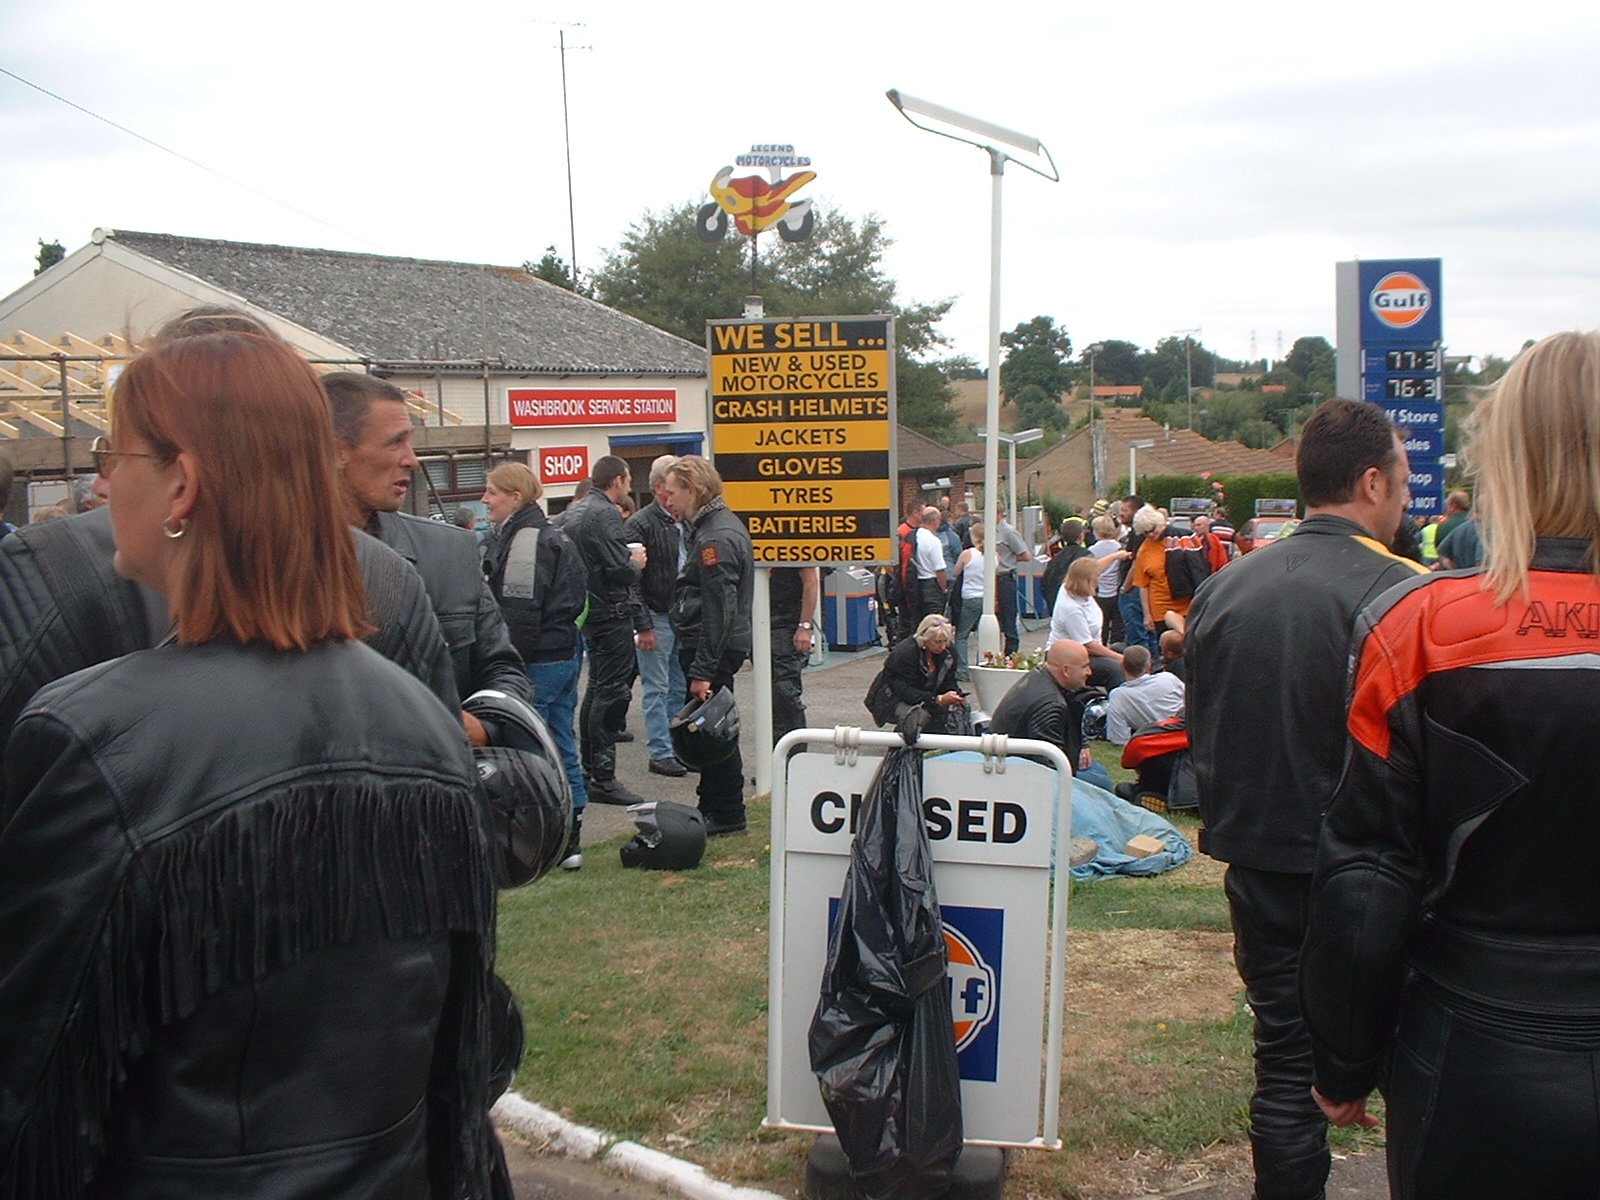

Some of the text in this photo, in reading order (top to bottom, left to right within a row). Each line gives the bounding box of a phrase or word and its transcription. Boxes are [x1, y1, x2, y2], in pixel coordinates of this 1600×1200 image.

[751, 144, 793, 152] LEGEND
[736, 155, 811, 166] MOTORCYCLES
[1374, 293, 1428, 308] Gulf
[715, 324, 764, 350] WE
[774, 321, 848, 349] SELL
[732, 354, 867, 373] NEW & USED
[722, 372, 879, 392] MOTORCYCLES
[513, 398, 673, 417] WASHBROOK SERVICE STATION
[714, 397, 888, 418] CRASH HELMETS
[1398, 408, 1438, 423] Store
[755, 428, 847, 446] JACKETS
[1404, 438, 1430, 450] ales
[544, 455, 583, 476] SHOP
[758, 457, 843, 476] GLOVES
[769, 487, 833, 504] TYRES
[748, 515, 857, 534] BATTERIES
[753, 545, 875, 562] CCESSORIES
[811, 791, 1028, 844] CSED
